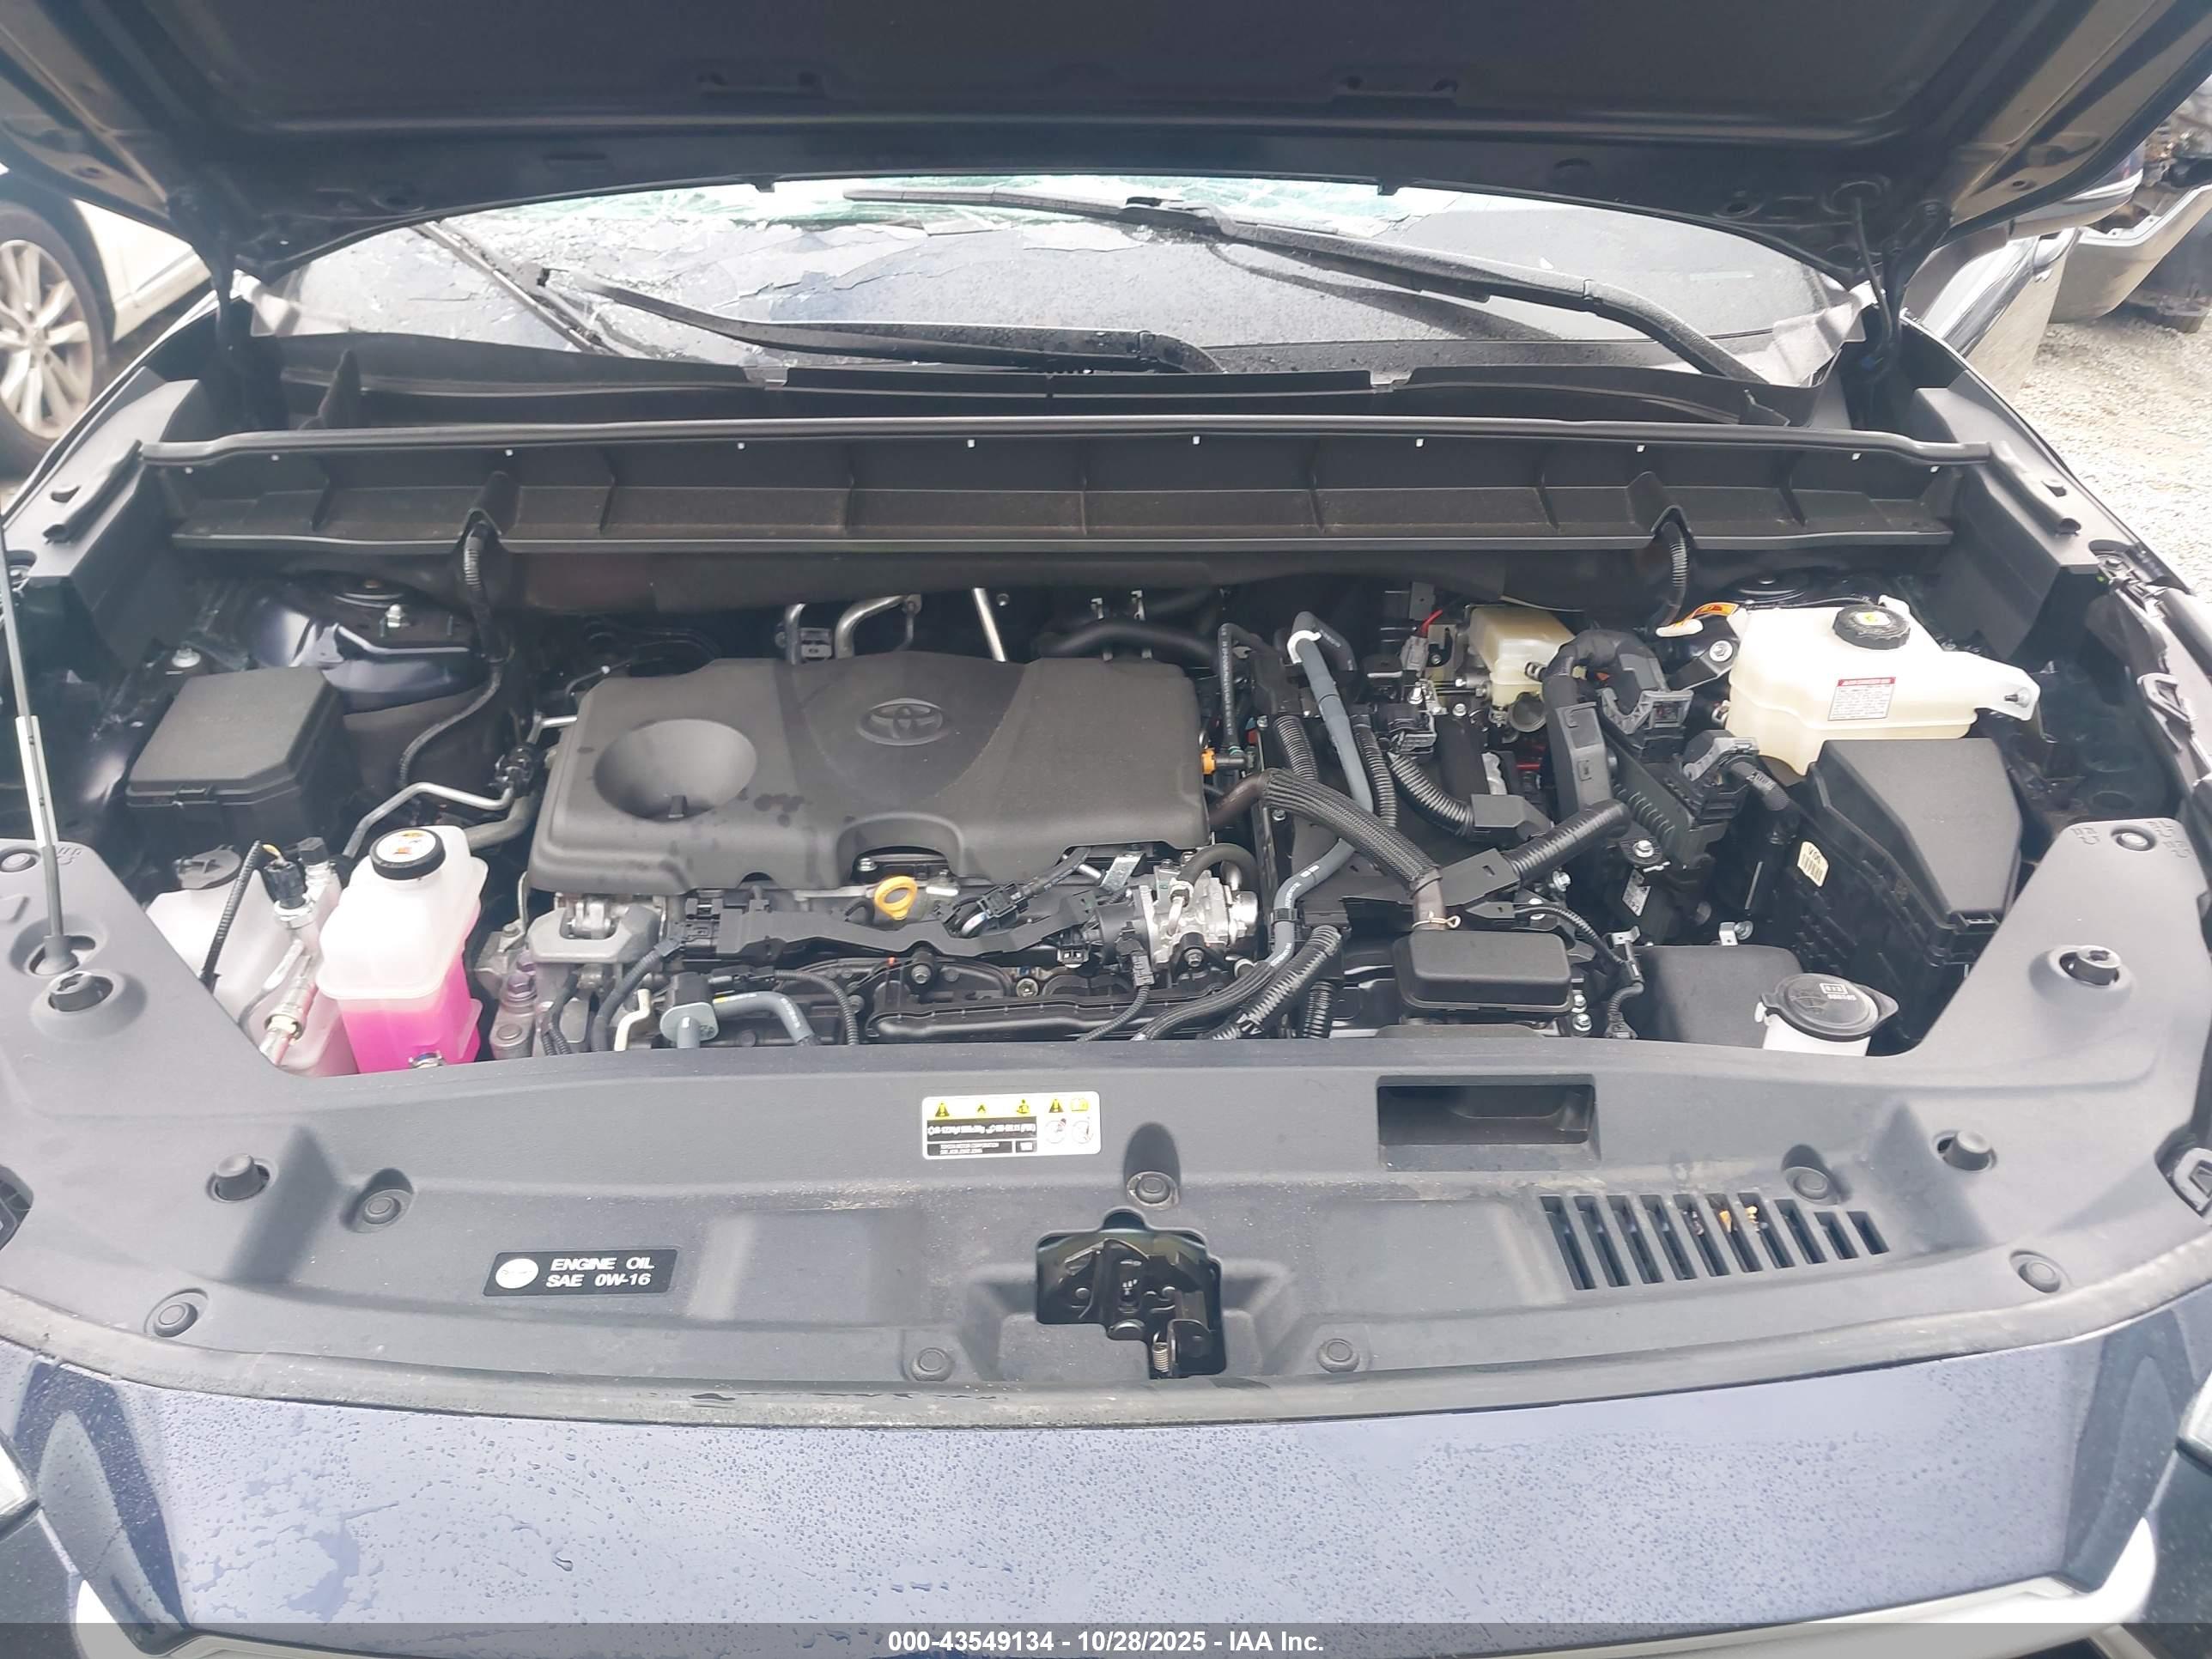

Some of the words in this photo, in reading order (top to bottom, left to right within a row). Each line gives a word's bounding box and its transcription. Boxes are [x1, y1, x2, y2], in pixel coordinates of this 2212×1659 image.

[550, 1257, 617, 1272] ENGINE
[626, 1256, 655, 1270] OIL
[545, 1273, 585, 1288] SAE
[594, 1273, 652, 1286] 0W-16
